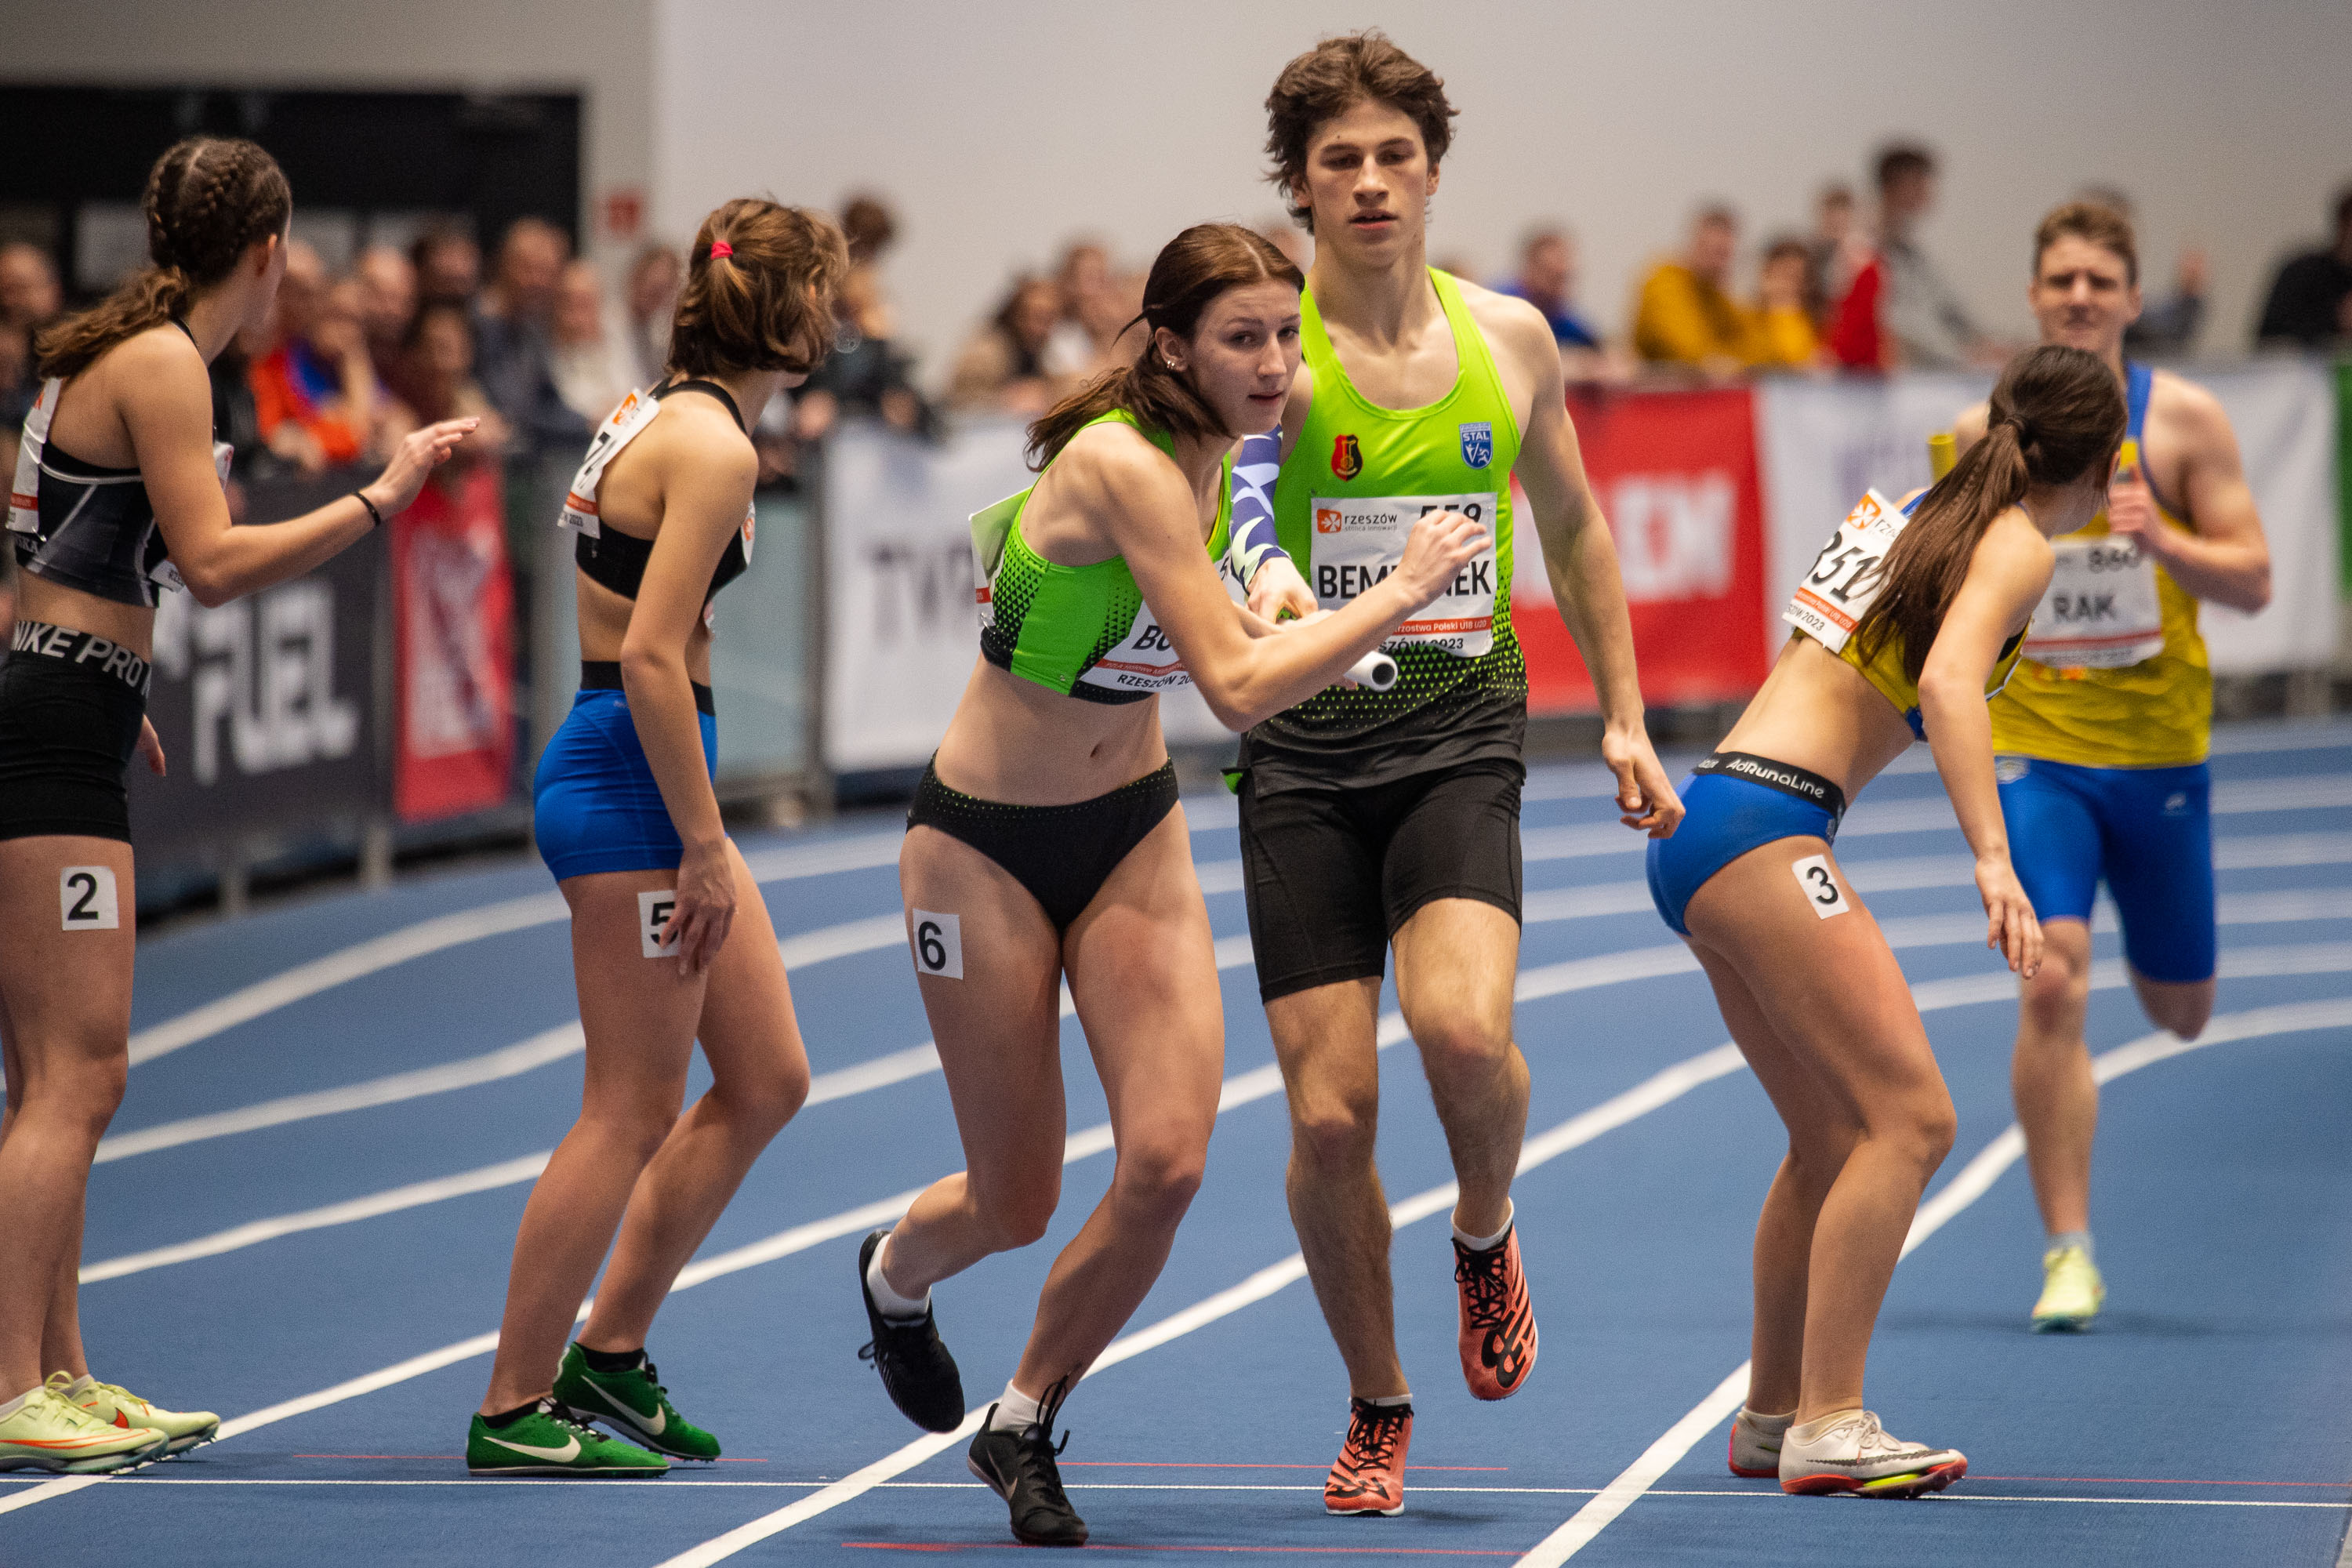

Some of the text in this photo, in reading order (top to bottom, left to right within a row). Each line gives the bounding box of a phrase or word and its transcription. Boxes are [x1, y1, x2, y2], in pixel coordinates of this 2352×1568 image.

[1462, 431, 1490, 441] STAL
[1345, 513, 1397, 524] rzeszów
[1318, 560, 1491, 599] BEMEK
[1802, 612, 1825, 631] 2023
[2053, 594, 2118, 622] RAK
[1433, 622, 1458, 632] Polski
[1459, 620, 1473, 630] U18
[1474, 619, 1486, 628] U20
[11, 620, 82, 659] NIKE
[75, 634, 143, 688] PRO
[1116, 673, 1192, 688] RZESZÓW 20
[67, 873, 98, 920] 2
[1806, 866, 1838, 905] 3
[650, 901, 679, 946] 5
[918, 921, 946, 971] 6
